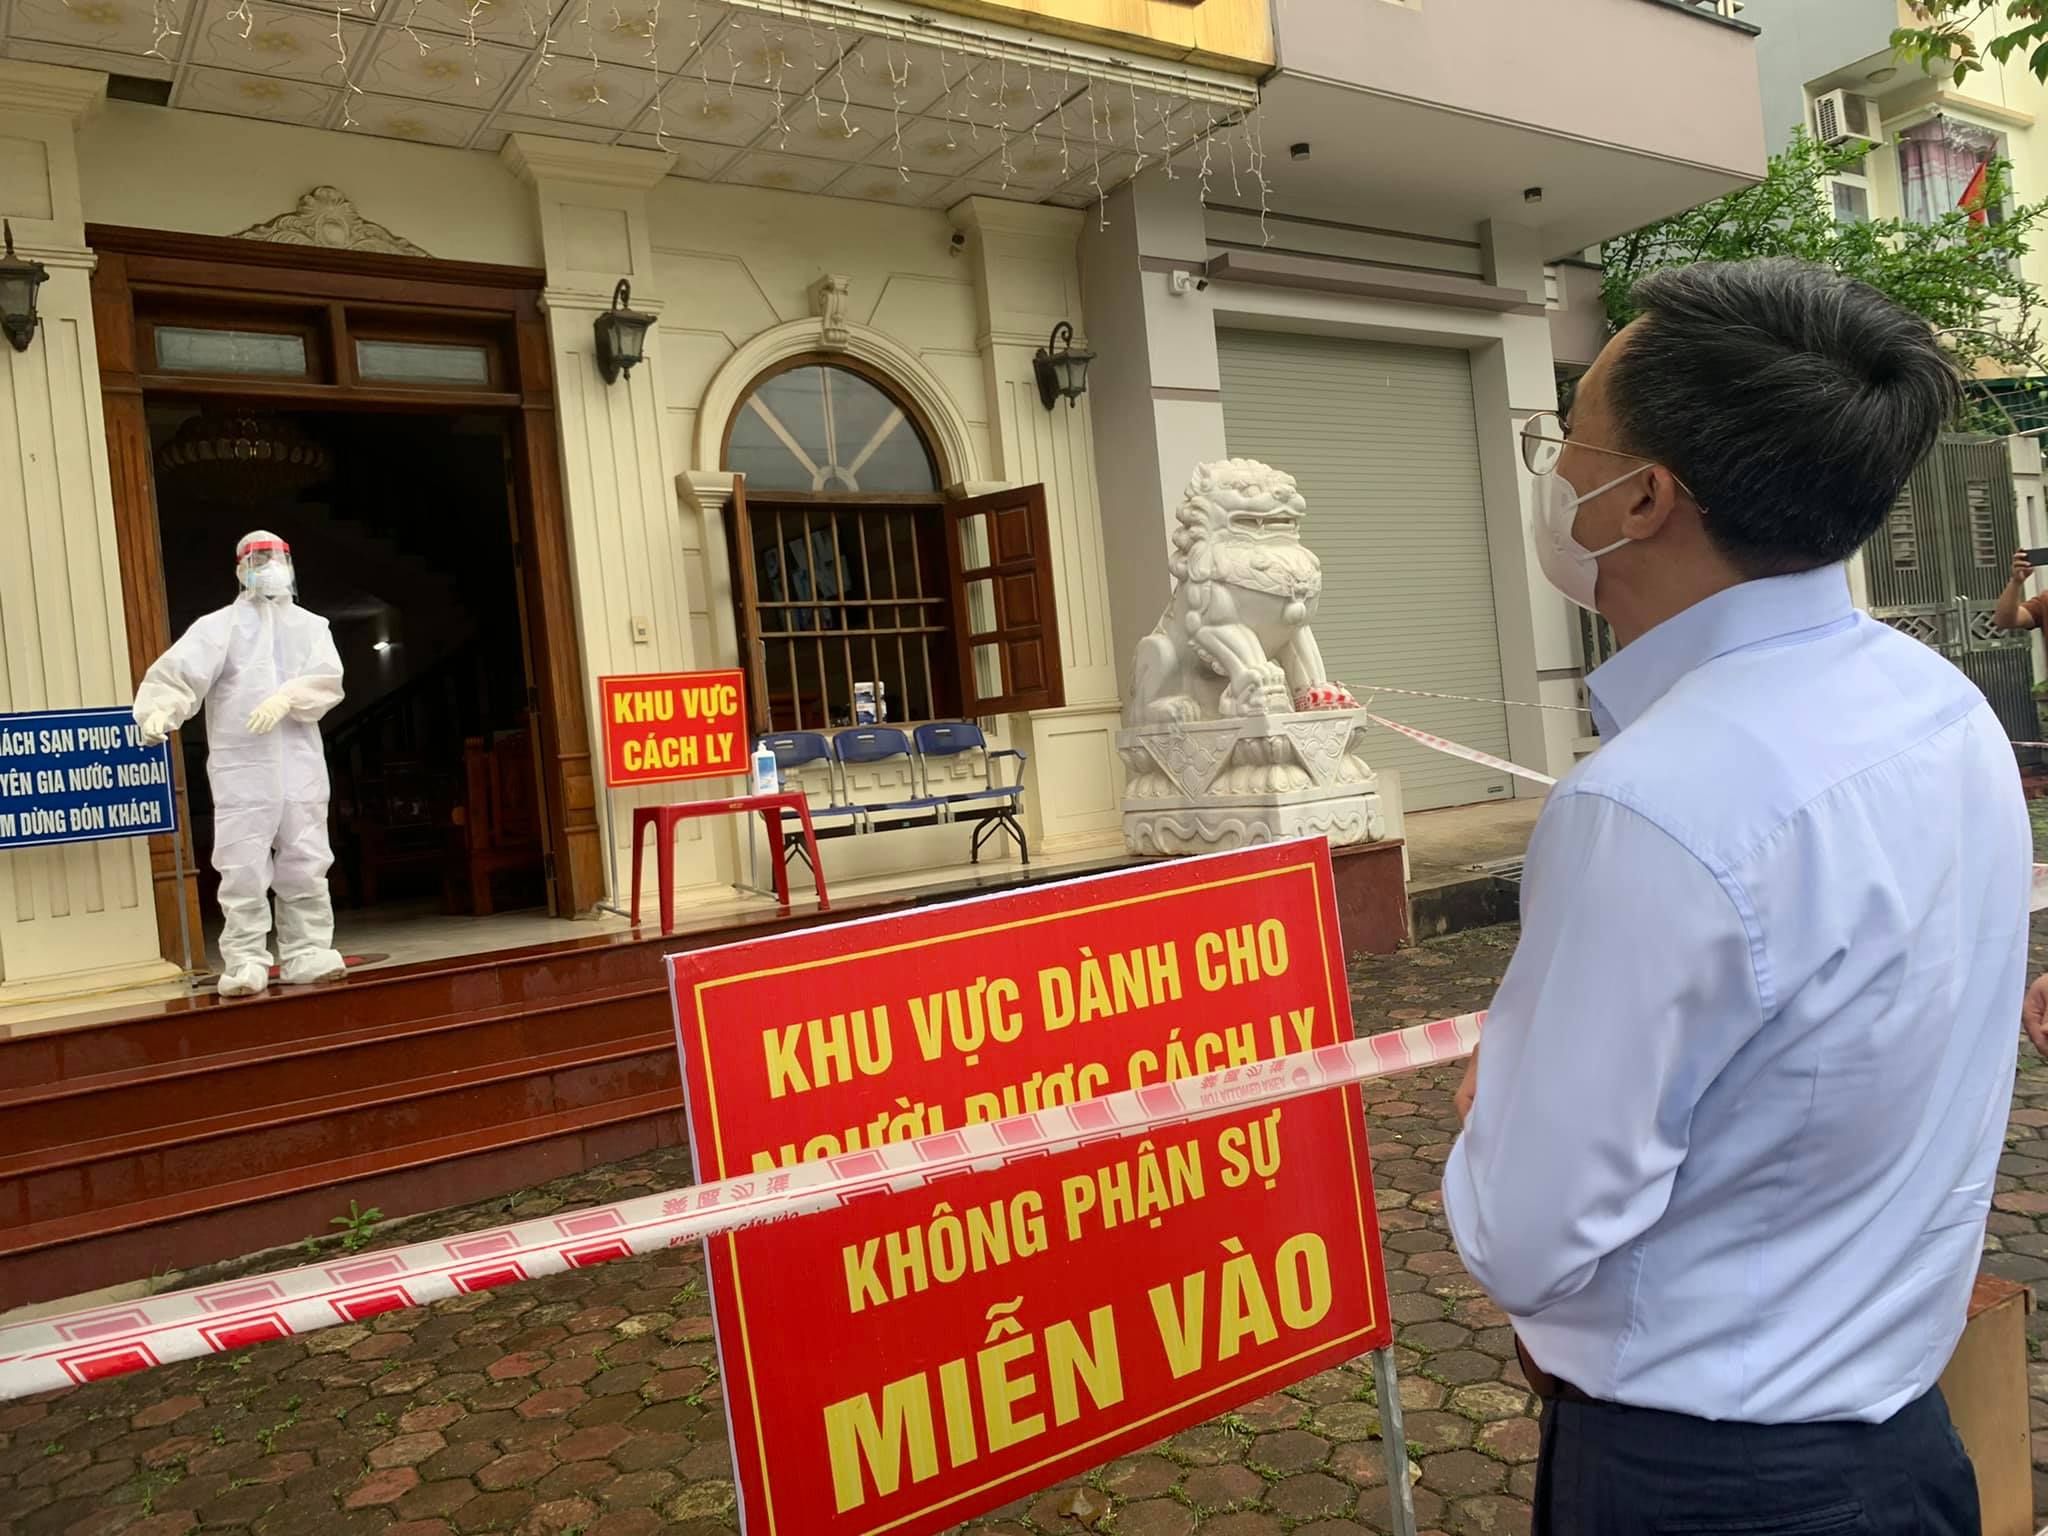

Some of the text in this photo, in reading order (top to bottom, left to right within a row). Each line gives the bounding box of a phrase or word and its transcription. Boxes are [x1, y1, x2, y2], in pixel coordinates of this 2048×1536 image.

[613, 684, 738, 724] KHU VỰC
[0, 724, 145, 758] ÁCH SẠN PHỤC VỤ
[623, 732, 734, 772] CÁCH LY
[36, 769, 65, 795] GIA
[68, 762, 114, 792] NƯỚC
[117, 757, 167, 787] NGOÀI
[20, 806, 67, 836] DỪNG
[70, 802, 104, 831] ĐÓN
[107, 798, 162, 828] KHÁCH
[762, 918, 1289, 1099] KHU VỰC DÀNH CHO
[1128, 1022, 1254, 1088] CÁCH
[842, 1108, 1284, 1314] KHÔNG PHẬN SỰ
[822, 1231, 1333, 1515] MIỄN VÀO
